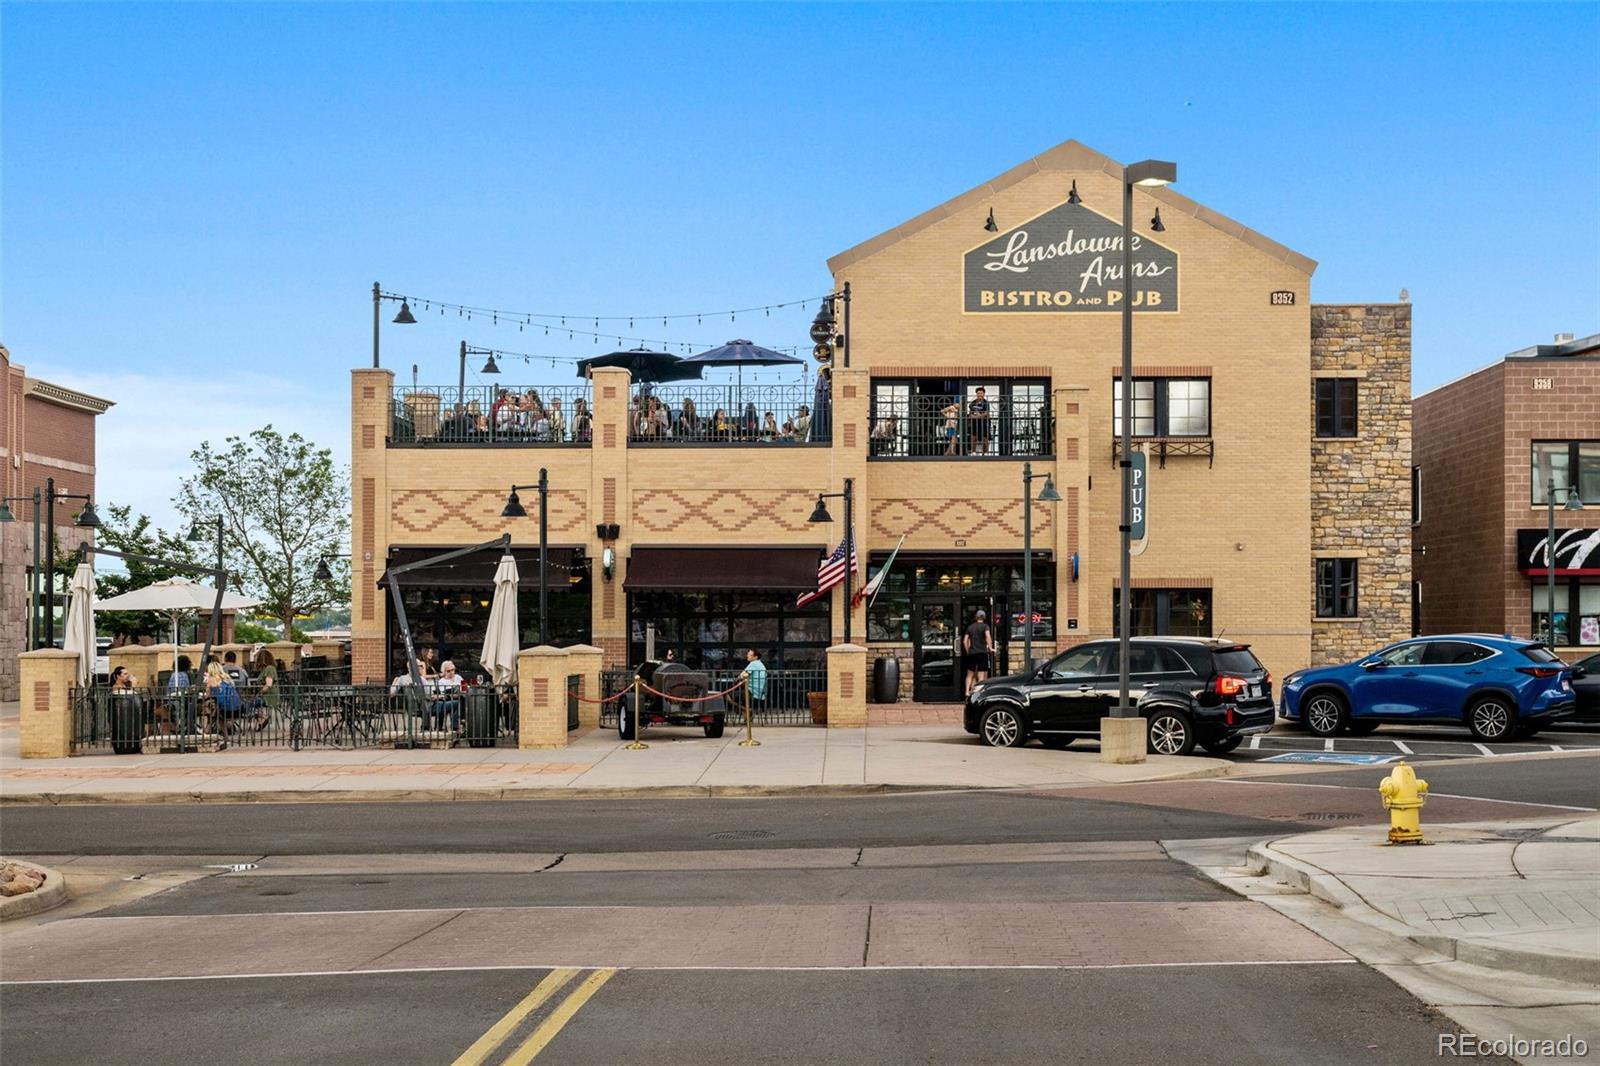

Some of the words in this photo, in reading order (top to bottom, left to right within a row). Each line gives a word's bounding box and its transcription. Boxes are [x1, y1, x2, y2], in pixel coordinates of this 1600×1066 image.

[983, 229, 1141, 272] Lansdowne
[1080, 256, 1172, 293] Arms
[980, 290, 1073, 306] BISTRO
[1076, 297, 1102, 305] AND
[1131, 469, 1143, 523] PUB
